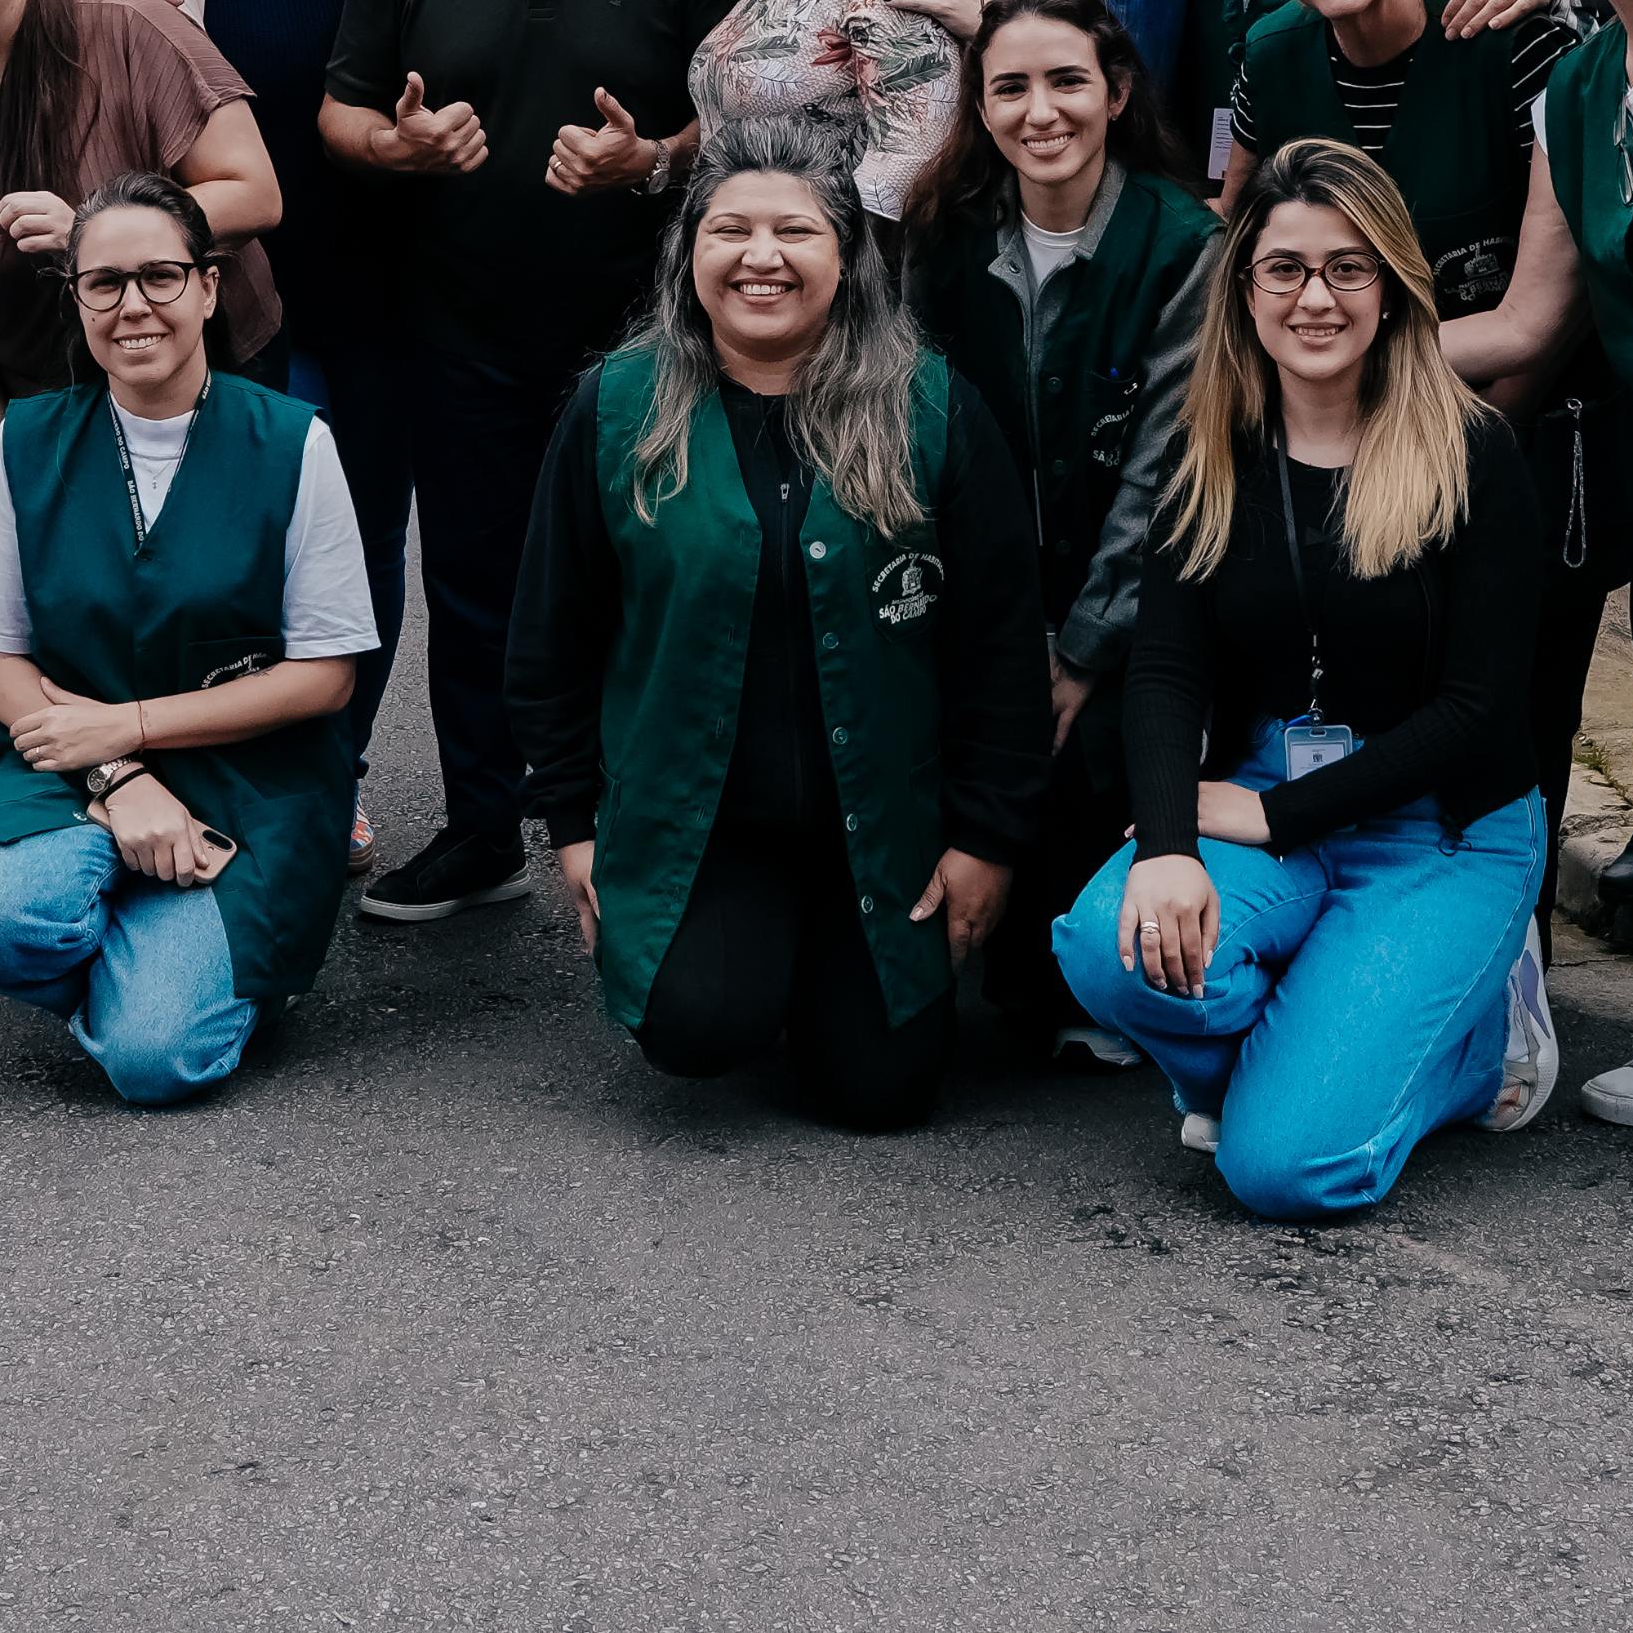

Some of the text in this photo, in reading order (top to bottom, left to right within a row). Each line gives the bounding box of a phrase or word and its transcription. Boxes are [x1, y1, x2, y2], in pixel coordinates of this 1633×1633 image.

[116, 436, 123, 445] DO
[120, 446, 129, 469] CAMPO
[130, 494, 142, 530] BERNARDO
[137, 531, 144, 541] DO
[872, 554, 906, 593] SECRETARIA
[879, 604, 896, 619] SÃO
[890, 613, 901, 624] DO
[201, 660, 243, 689] SECRETARIA
